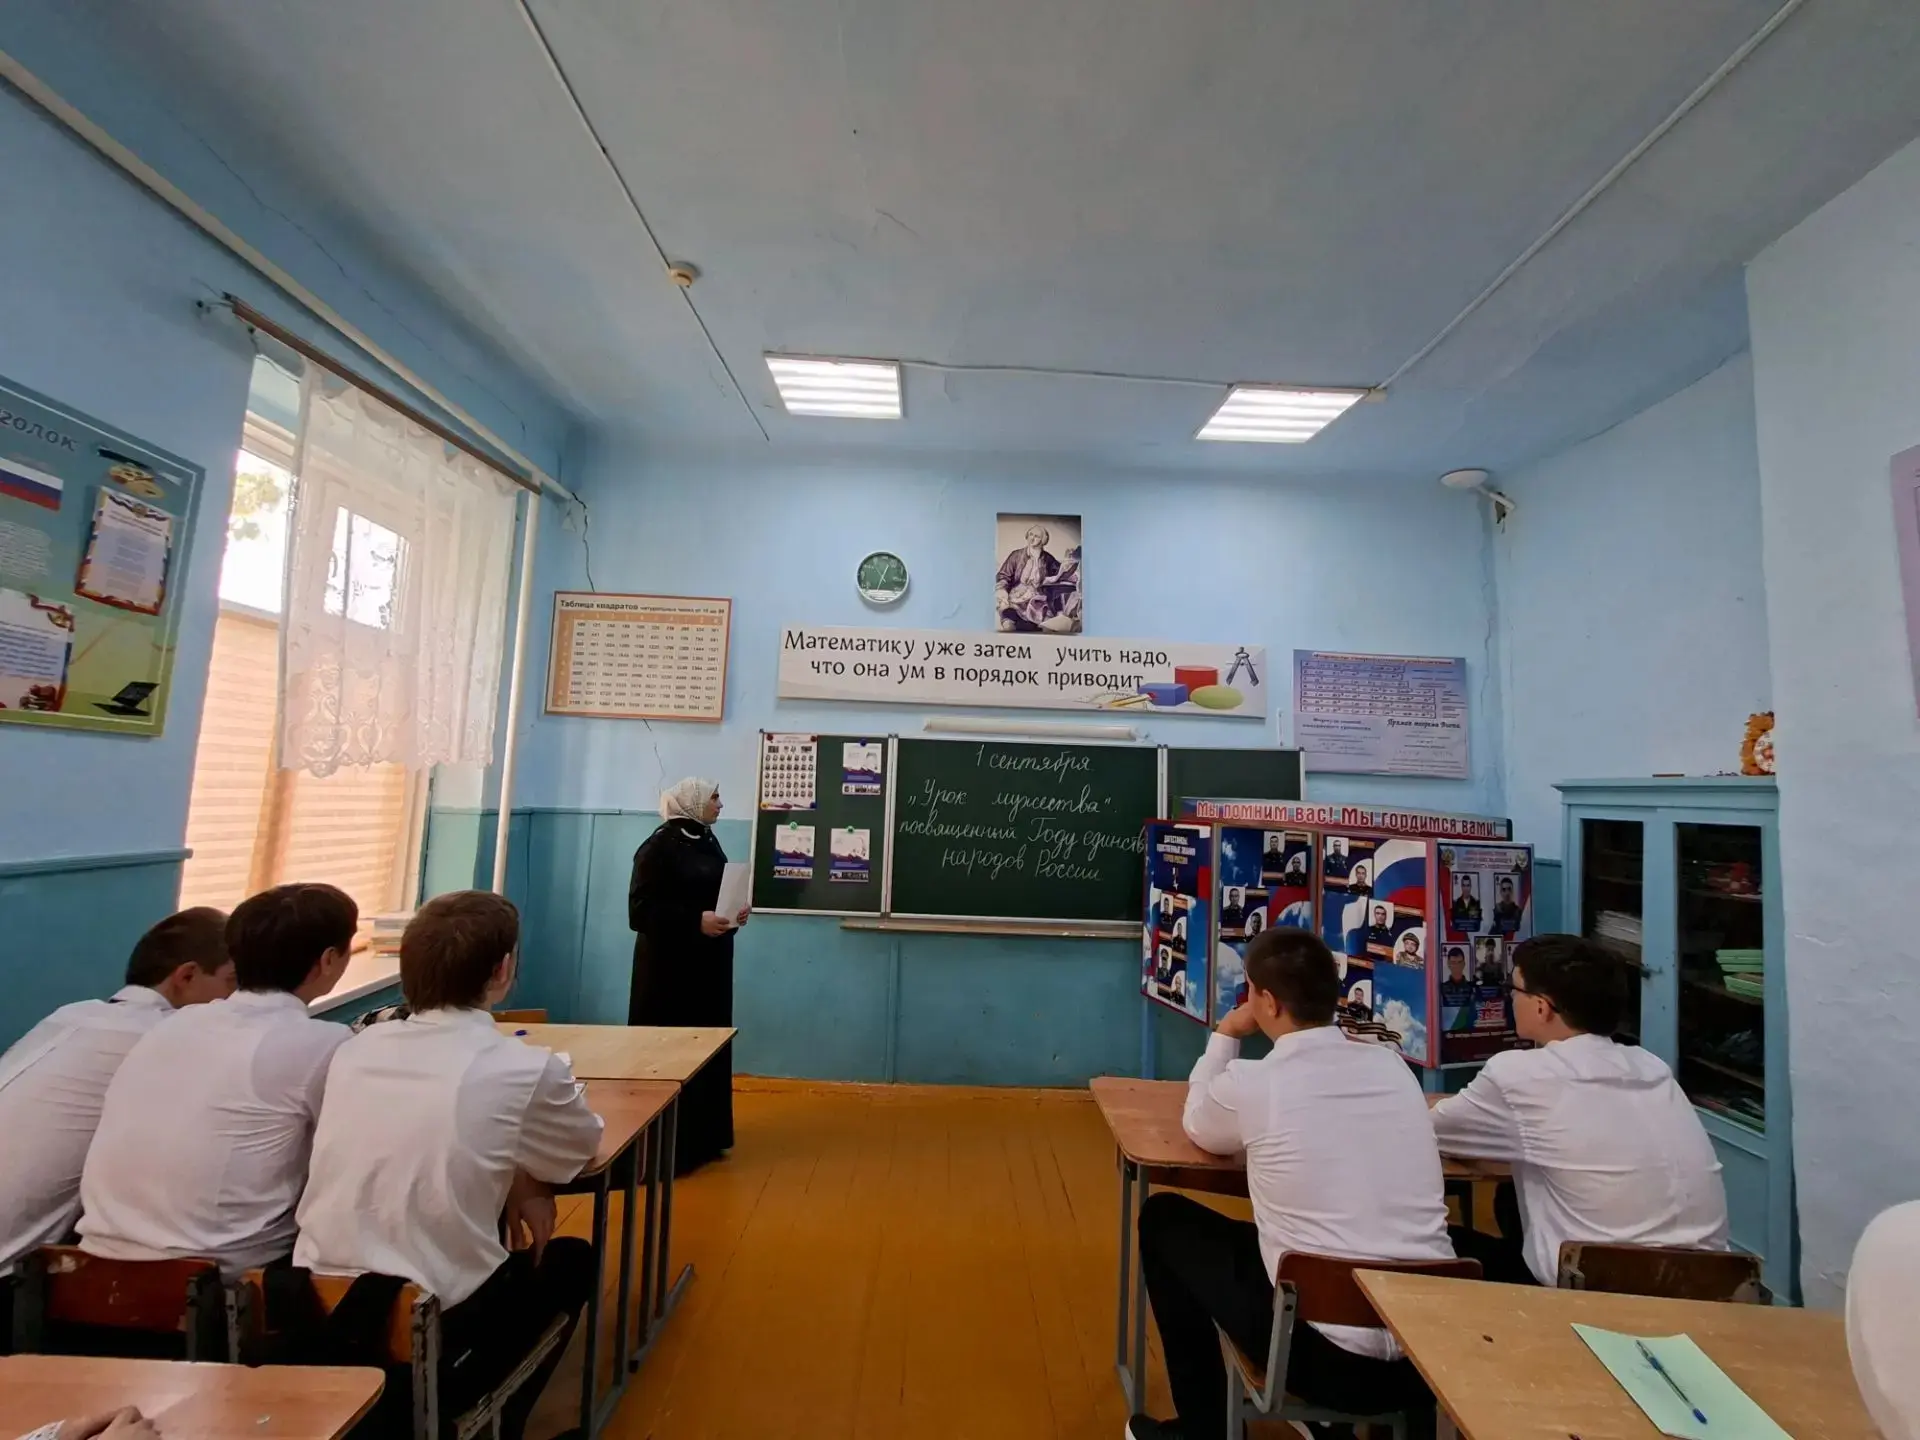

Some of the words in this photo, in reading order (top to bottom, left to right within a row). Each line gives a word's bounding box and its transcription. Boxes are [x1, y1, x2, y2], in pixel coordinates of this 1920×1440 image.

[0, 408, 77, 452] голок
[560, 600, 595, 609] Таблица
[596, 602, 639, 611] квадратов
[784, 630, 915, 660] Математику
[923, 639, 966, 661] уже
[973, 642, 1032, 659] затем
[1055, 645, 1112, 666] учить
[1120, 649, 1172, 668] надо,
[811, 660, 846, 676] что
[853, 662, 890, 677] она
[897, 663, 925, 684] ум
[934, 666, 945, 680] в
[954, 667, 1039, 687] порядок
[1048, 671, 1144, 691] приводит
[977, 744, 985, 767] 1
[989, 751, 1092, 783] сентября
[1197, 802, 1220, 818] Мы
[1222, 803, 1289, 821] помним
[1295, 807, 1335, 824] вас!
[1341, 807, 1374, 826] Мы
[1382, 811, 1457, 834] гордимся
[1462, 819, 1498, 838] вами!
[1028, 817, 1078, 860] Году
[1083, 825, 1146, 861] единств
[942, 844, 1027, 881] народов
[1035, 848, 1102, 881] России
